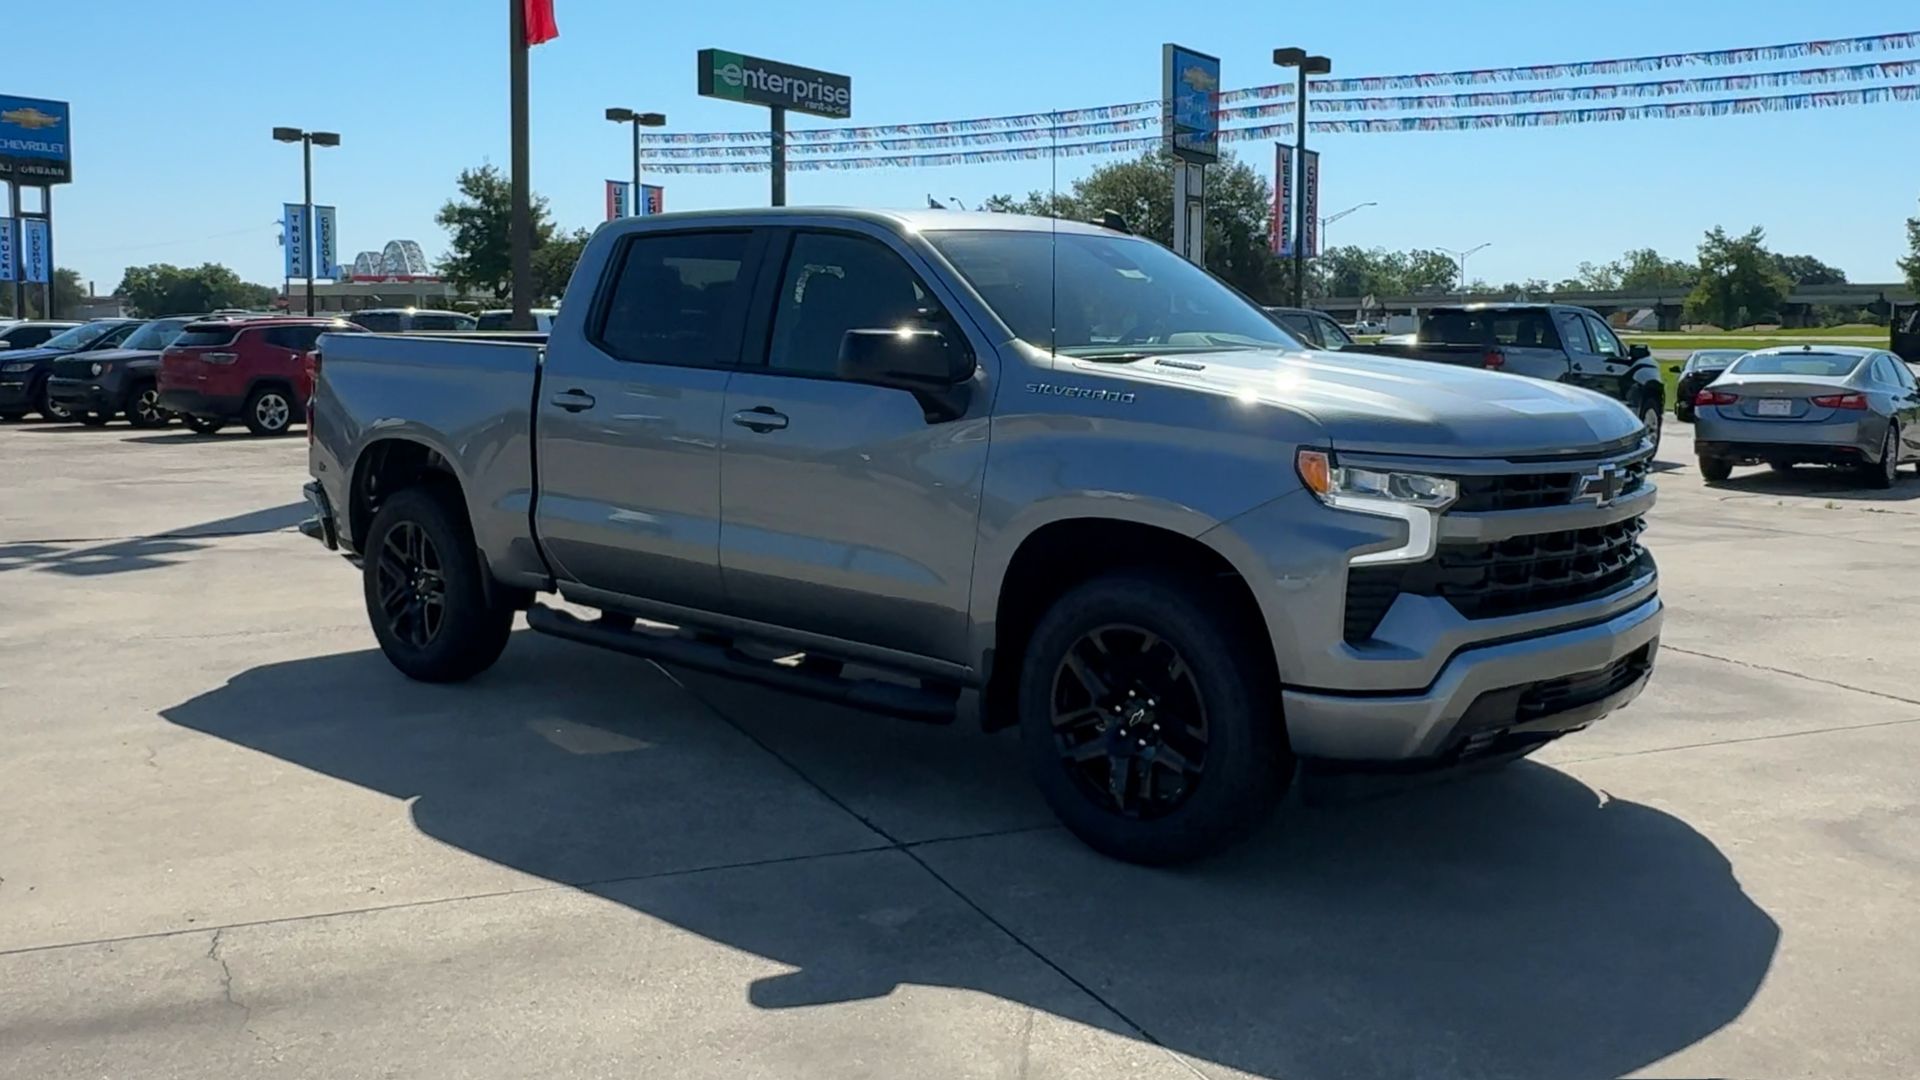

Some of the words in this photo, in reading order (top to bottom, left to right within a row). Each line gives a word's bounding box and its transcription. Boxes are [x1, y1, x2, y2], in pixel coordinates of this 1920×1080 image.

[717, 63, 849, 104] enterprise
[0, 138, 64, 153] CHEVROLET
[1, 226, 10, 278] TRUCKS
[291, 214, 300, 274] TRUCKS
[1026, 383, 1135, 403] SILVERADO
